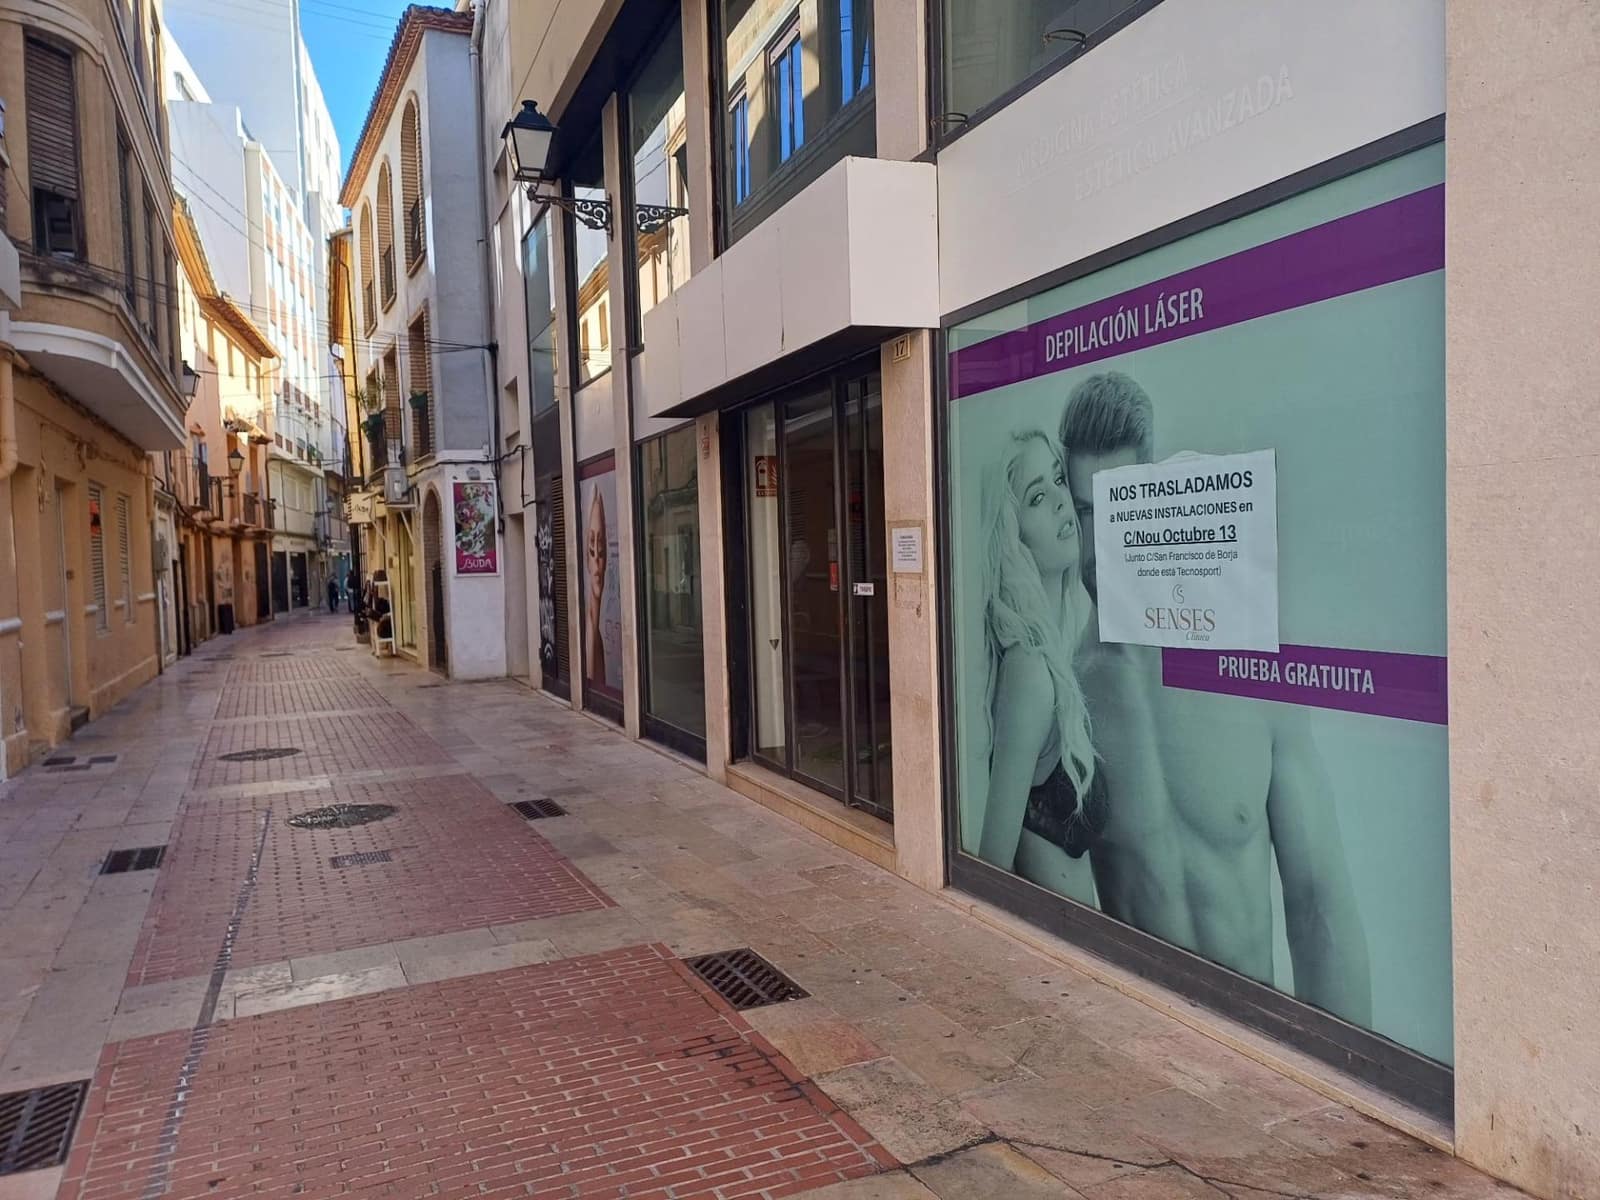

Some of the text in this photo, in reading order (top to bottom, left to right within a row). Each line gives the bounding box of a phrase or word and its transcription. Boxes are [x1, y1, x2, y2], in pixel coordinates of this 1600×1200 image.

[1162, 62, 1295, 153] AVANZADA
[1045, 286, 1204, 363] DEPILACIÓN LÁSER
[895, 340, 905, 356] 17
[1109, 470, 1253, 502] NOS TRASLADAMOS
[1109, 501, 1254, 523] a NUEVAS INSTALACIONES en
[1123, 524, 1237, 545] C/Nou Octubre 13
[1146, 551, 1168, 562] C/San
[1168, 551, 1204, 561] Francisco
[1205, 550, 1216, 560] de
[1216, 549, 1239, 562] Borja
[1137, 567, 1160, 577] donde
[1176, 565, 1222, 578] Tecnosport)
[1143, 607, 1216, 632] SENSES
[1218, 655, 1375, 695] PRUEBA GRATUITA
